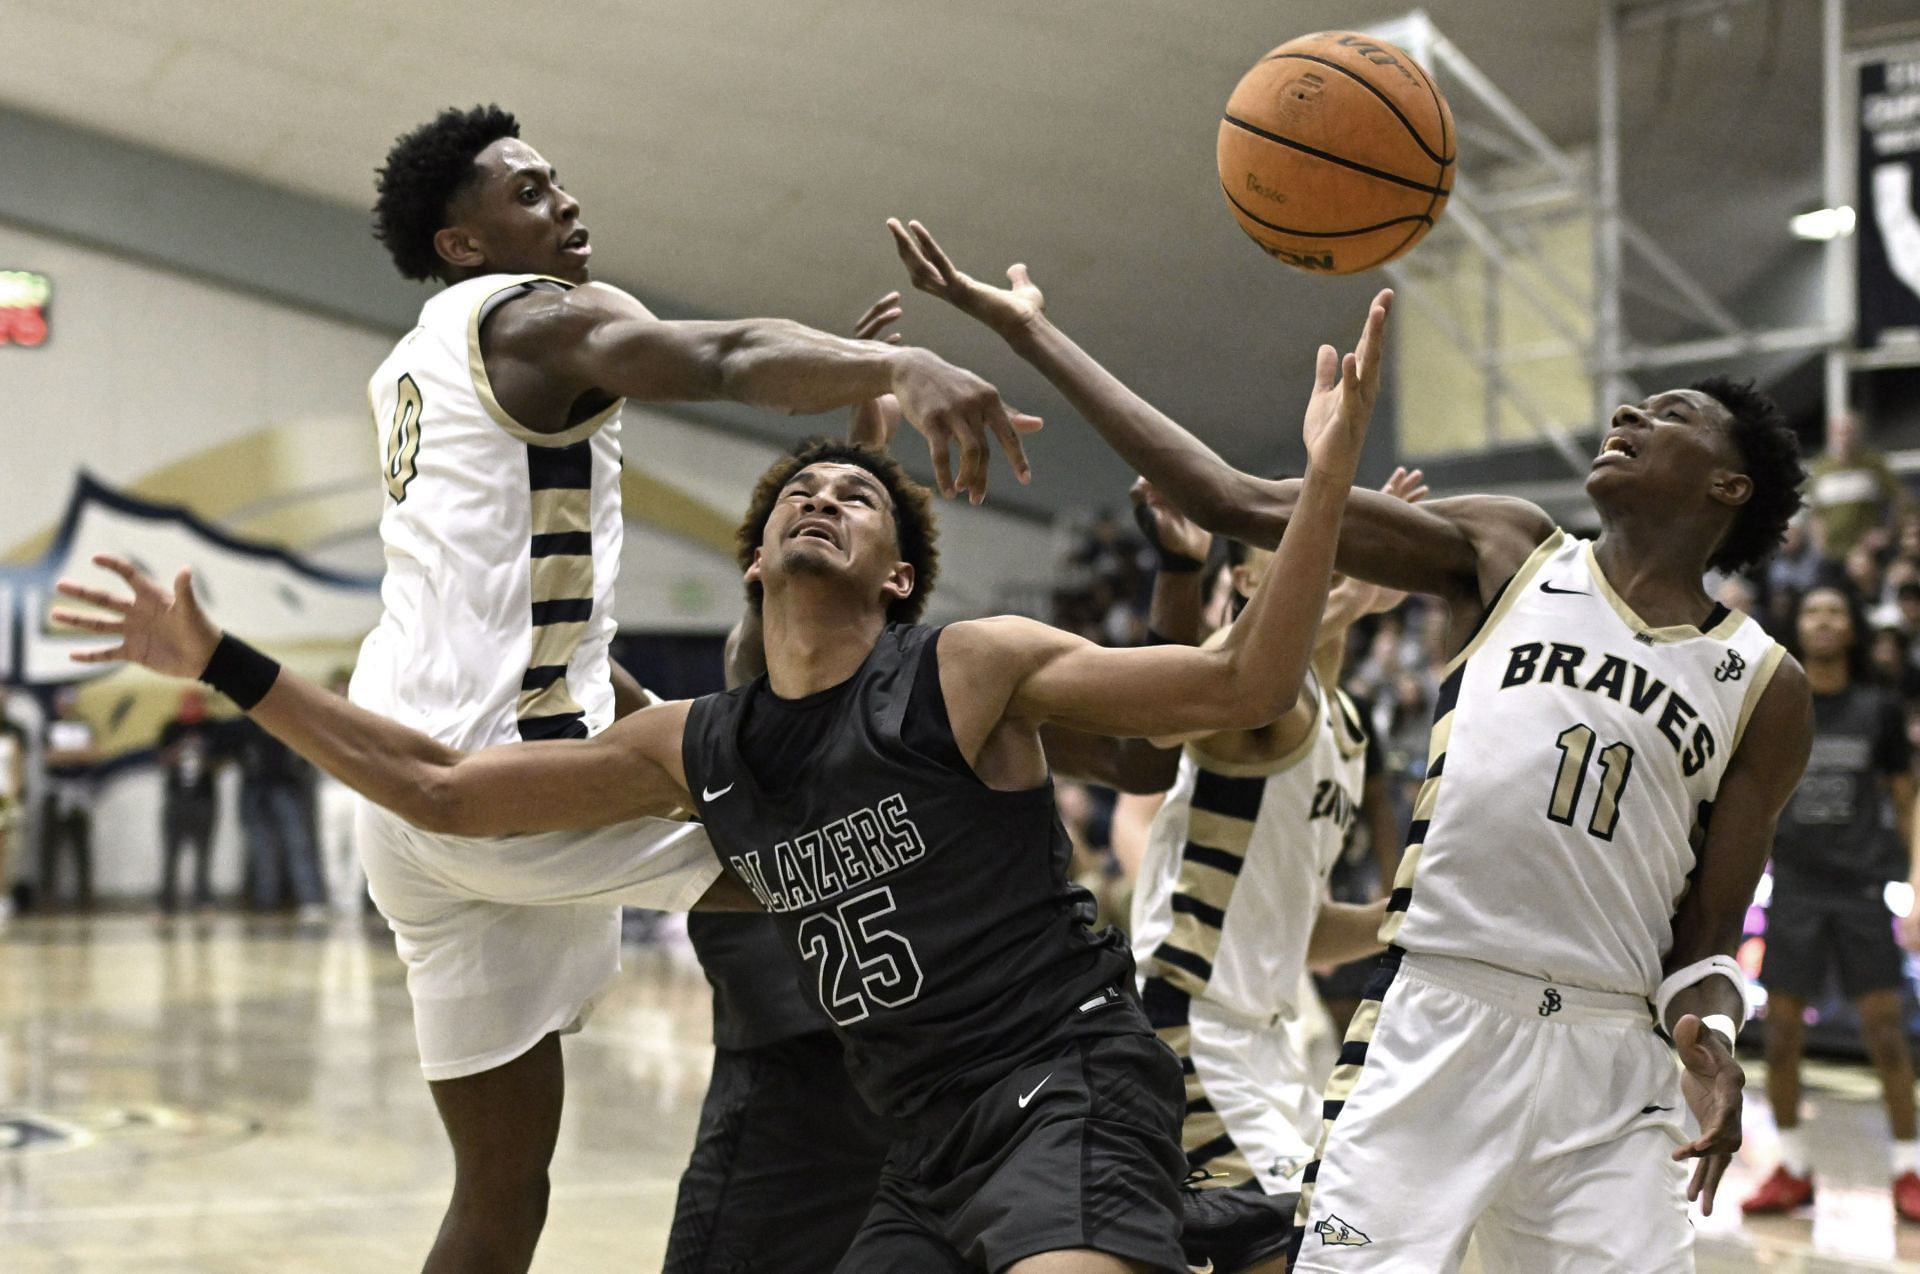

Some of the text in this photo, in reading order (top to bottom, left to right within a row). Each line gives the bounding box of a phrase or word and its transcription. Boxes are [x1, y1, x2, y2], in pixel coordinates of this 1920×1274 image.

[384, 372, 424, 505] 0
[1500, 642, 1715, 777] BRAVES
[1547, 722, 1635, 842] 11
[730, 793, 926, 914] BLAZERS
[798, 885, 924, 1027] 25
